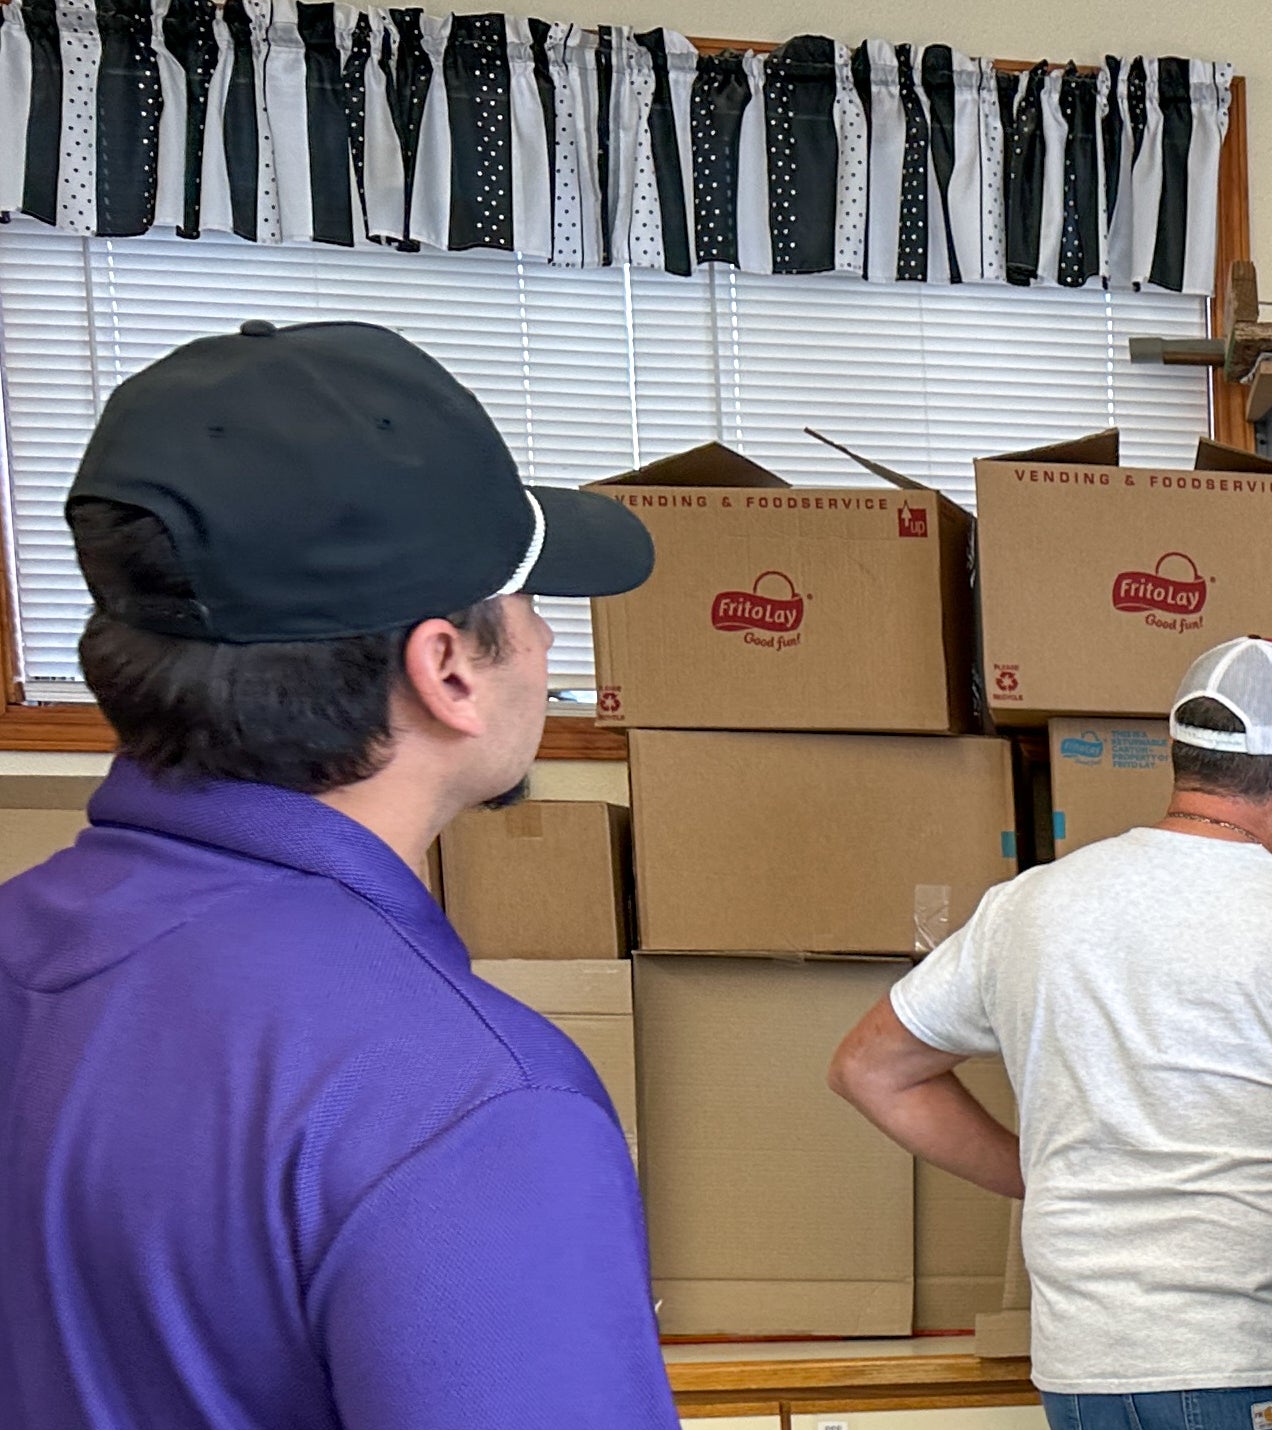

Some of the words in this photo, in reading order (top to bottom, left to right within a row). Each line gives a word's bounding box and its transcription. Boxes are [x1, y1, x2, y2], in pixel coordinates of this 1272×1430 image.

[1014, 469, 1110, 486] VENDING
[1125, 475, 1136, 486] &
[615, 495, 708, 508] VENDING
[721, 496, 732, 508] &
[746, 496, 888, 510] FOODSERVICE
[908, 519, 926, 535] up
[1145, 613, 1176, 630] Good
[1178, 616, 1204, 634] fun!
[744, 632, 774, 648] Good
[776, 632, 801, 652] fun!
